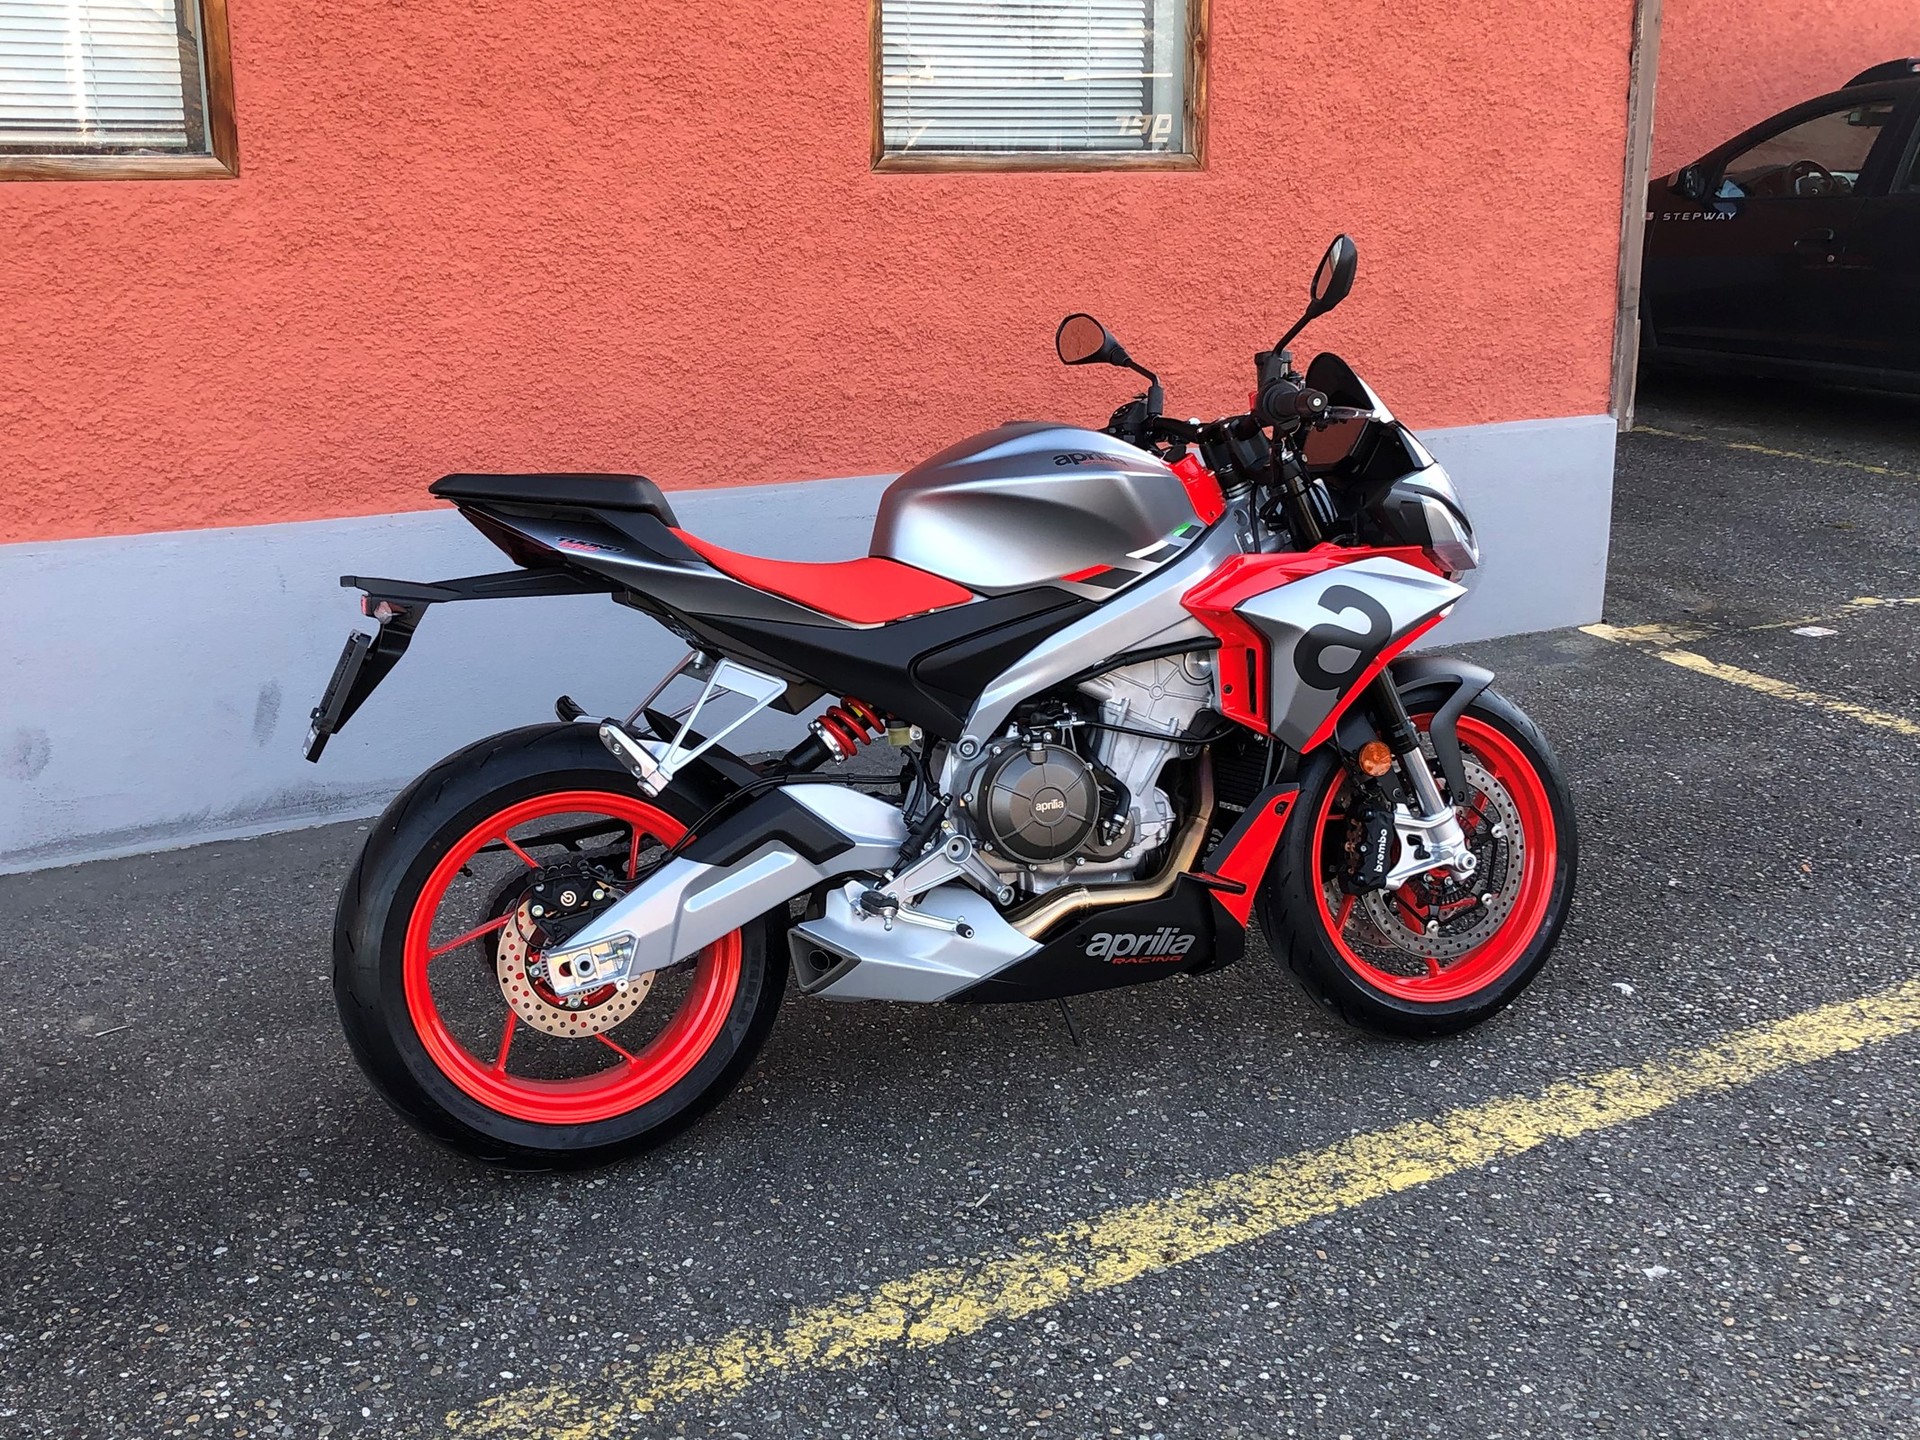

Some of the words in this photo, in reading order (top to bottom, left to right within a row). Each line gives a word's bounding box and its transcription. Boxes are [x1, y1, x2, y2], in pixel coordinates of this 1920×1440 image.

[1663, 211, 1736, 221] STEPWAY
[1035, 798, 1064, 813] aprilia
[1373, 828, 1388, 873] brembo
[1085, 926, 1196, 962] aprilia
[1112, 955, 1184, 965] RACING
